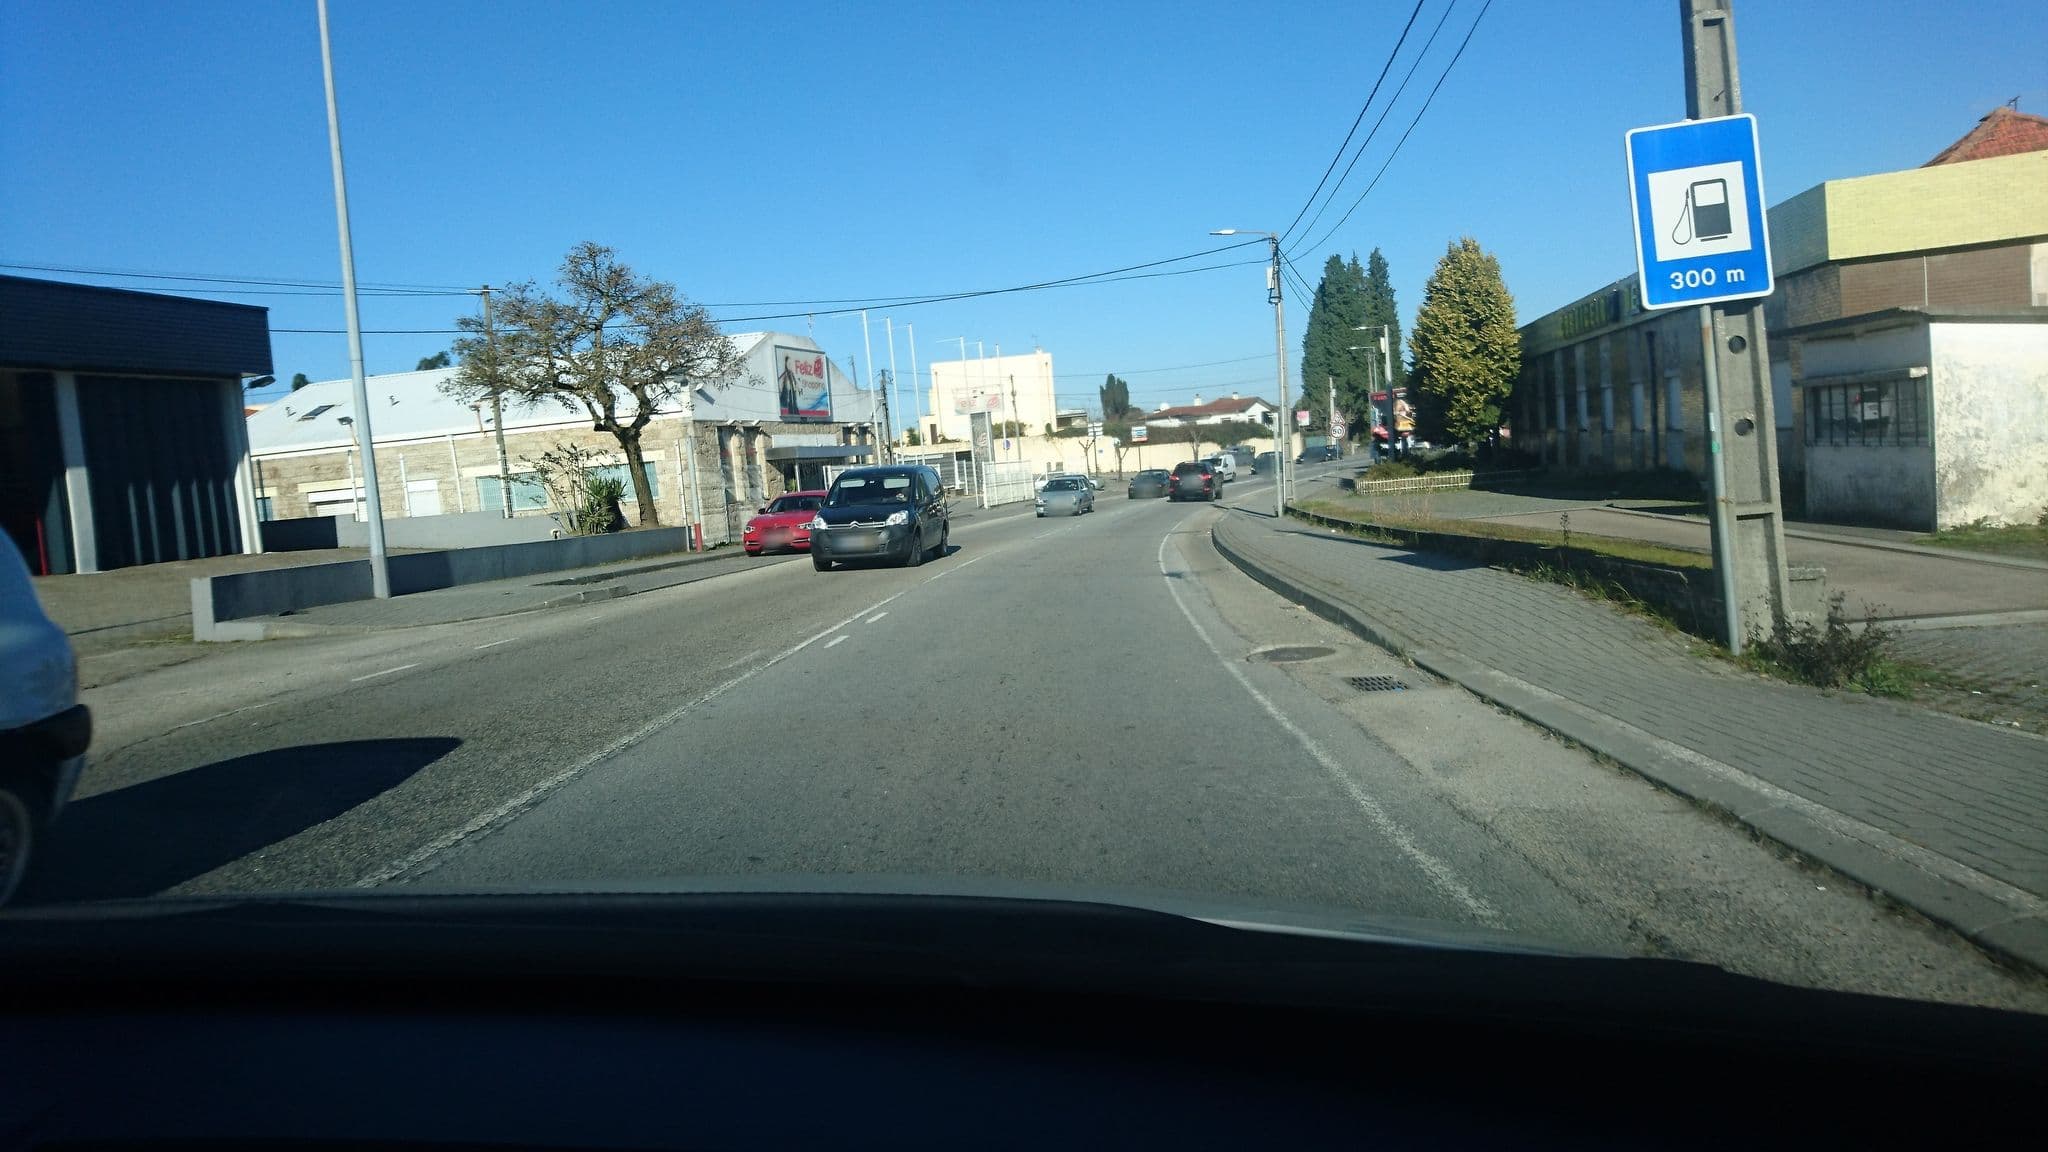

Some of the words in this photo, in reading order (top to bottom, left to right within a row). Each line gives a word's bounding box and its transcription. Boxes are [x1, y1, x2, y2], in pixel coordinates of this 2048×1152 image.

[1669, 268, 1716, 290] 300
[1726, 268, 1745, 283] m
[794, 360, 814, 376] Feliz
